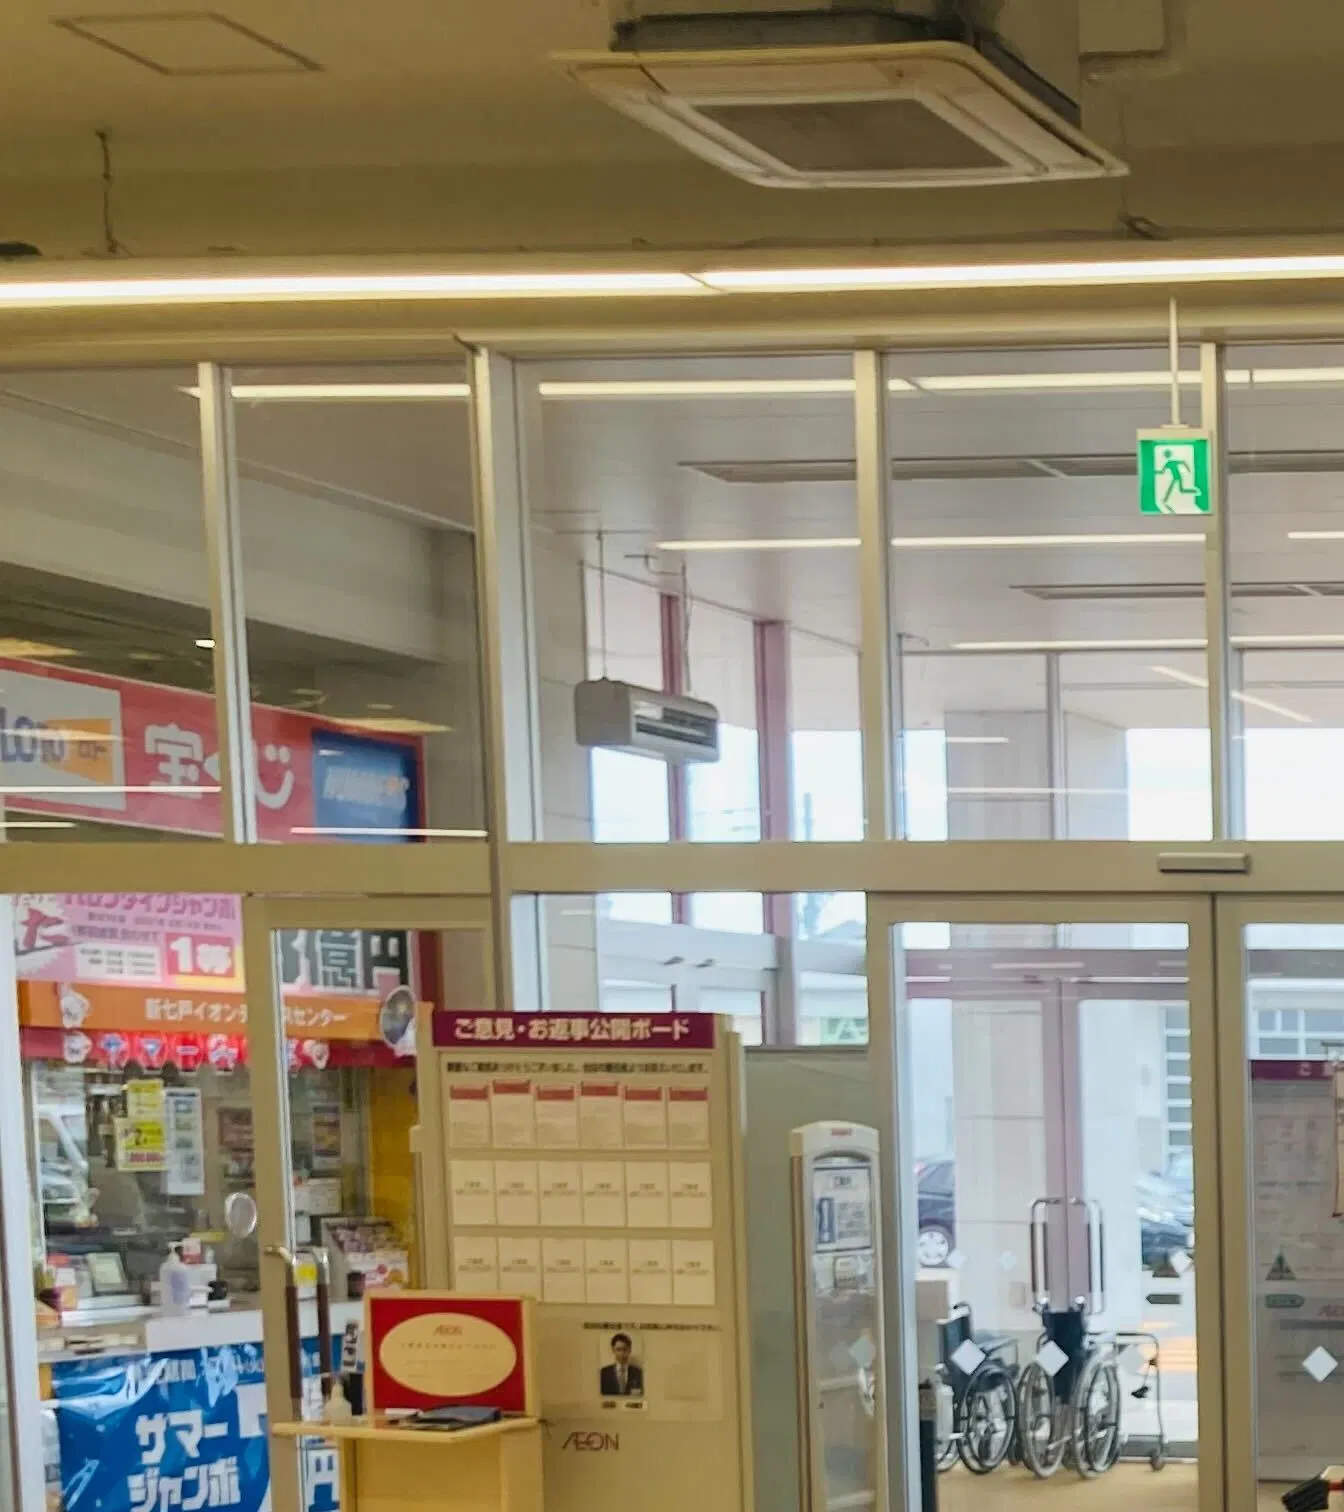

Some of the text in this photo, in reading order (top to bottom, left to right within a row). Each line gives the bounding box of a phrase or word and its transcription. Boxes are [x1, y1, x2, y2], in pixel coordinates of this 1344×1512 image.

[145, 723, 294, 808] 宝じ
[454, 1017, 690, 1041] ご意見・お返事公開ボード
[135, 1408, 229, 1465] サマー
